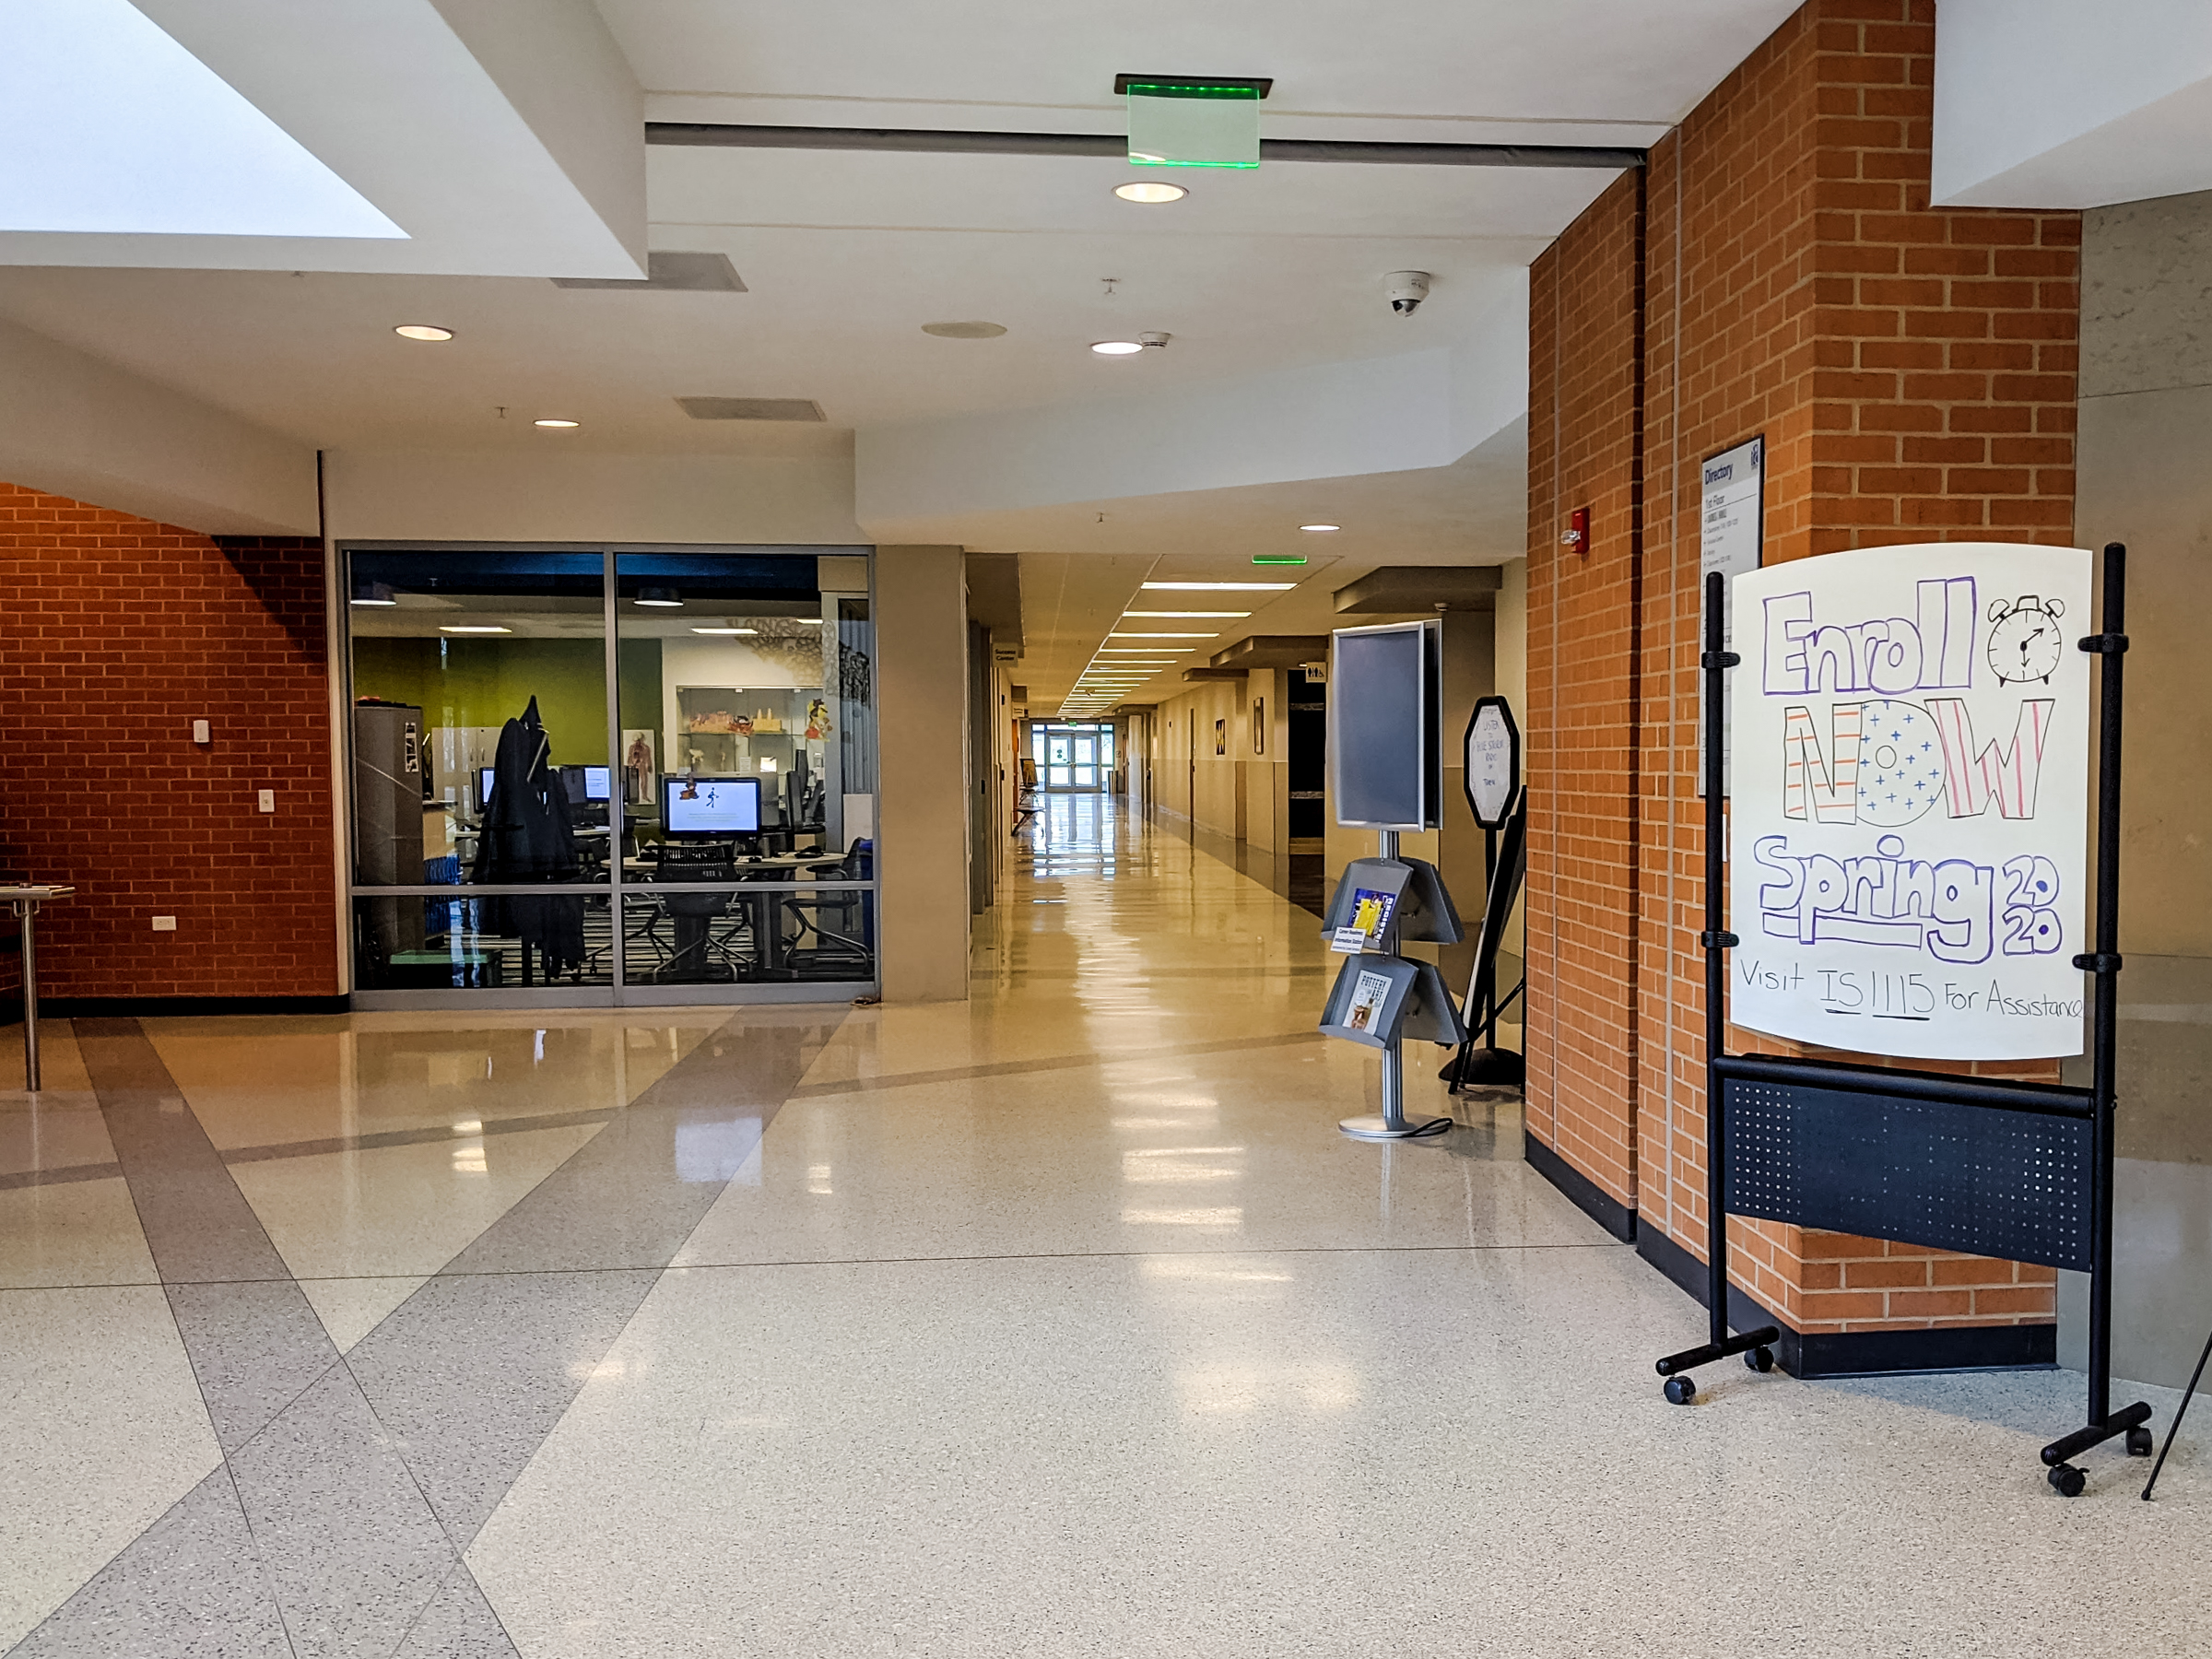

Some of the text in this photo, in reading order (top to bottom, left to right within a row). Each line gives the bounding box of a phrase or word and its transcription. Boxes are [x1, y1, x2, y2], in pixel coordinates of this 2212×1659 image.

[1705, 464, 1733, 485] Directory
[1762, 576, 1977, 695] Enroll
[1784, 698, 2056, 828] NOW
[1754, 834, 1994, 964] Spring
[1361, 975, 1387, 991] POTTERY
[1740, 959, 1805, 991] Visit
[1945, 982, 1980, 1010] For
